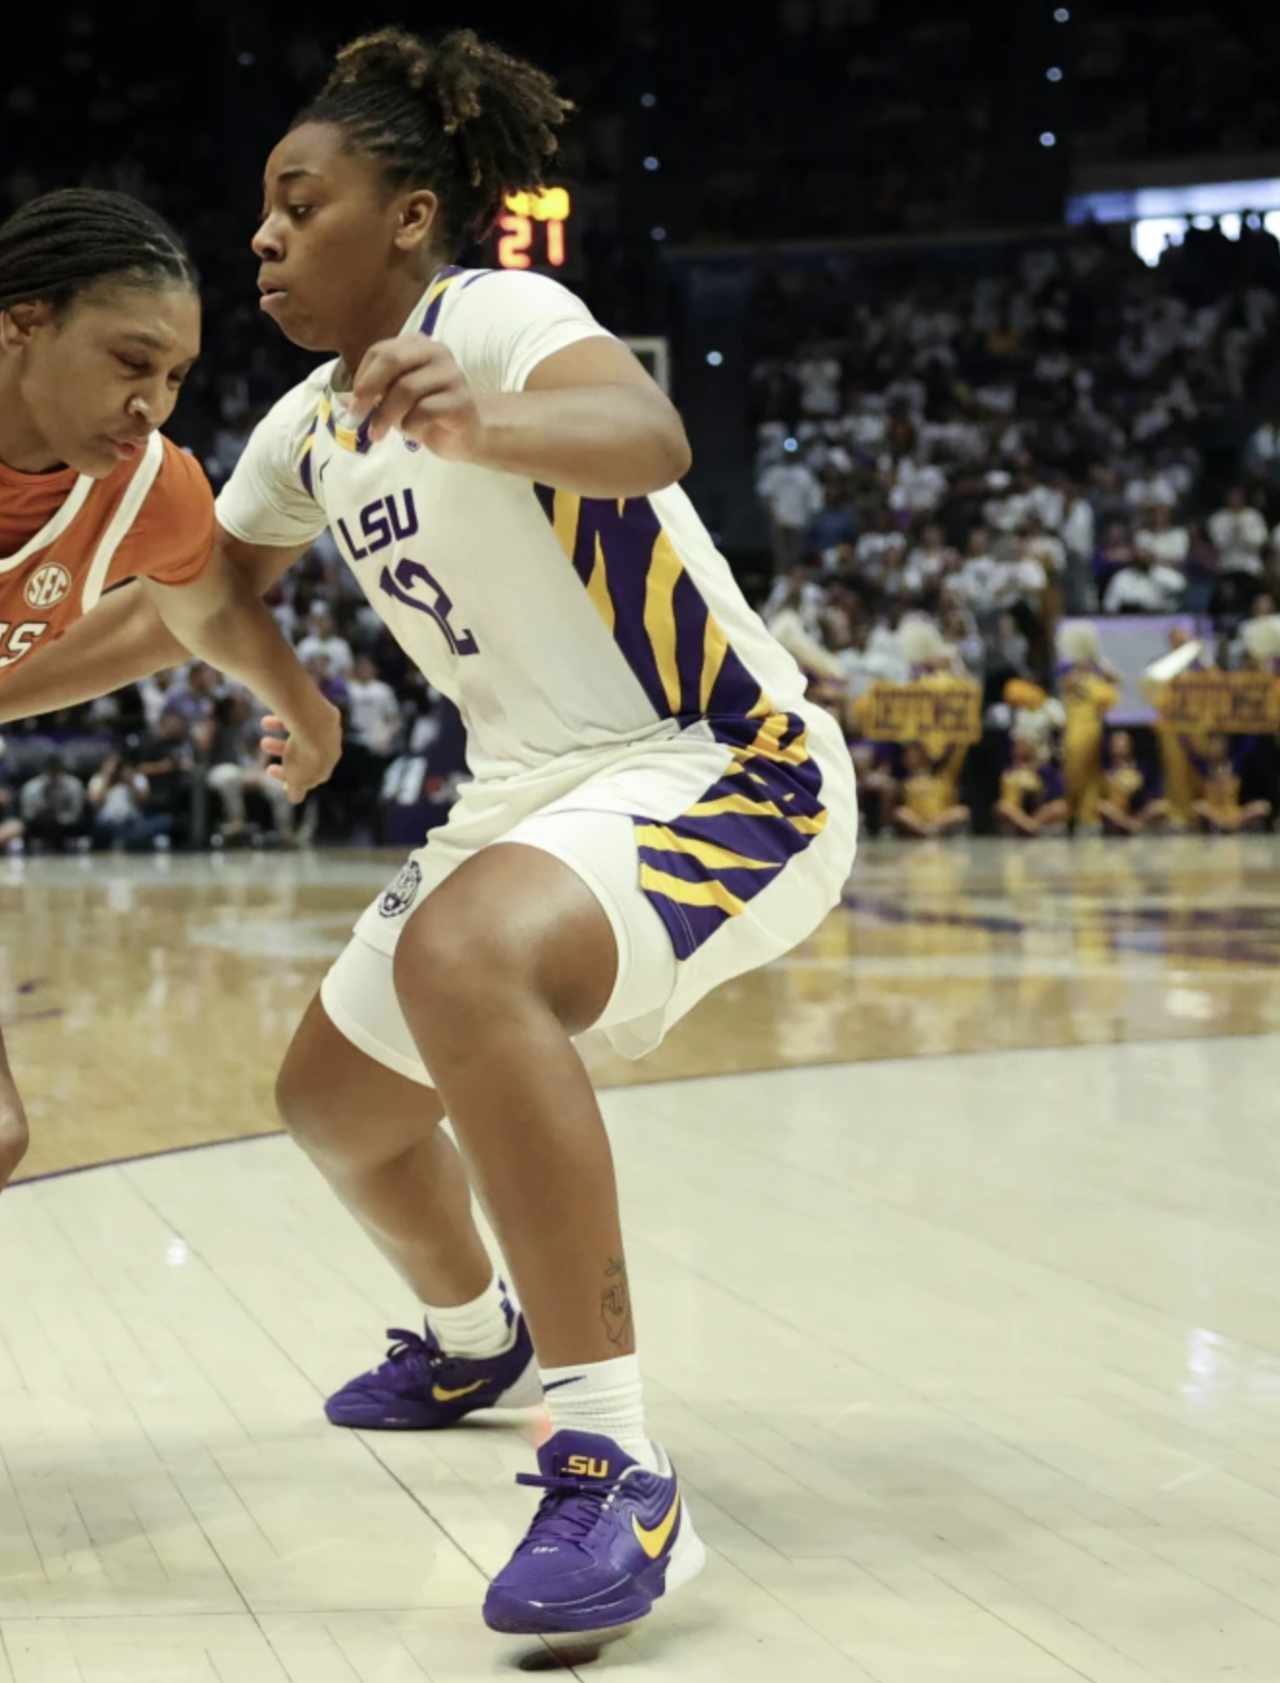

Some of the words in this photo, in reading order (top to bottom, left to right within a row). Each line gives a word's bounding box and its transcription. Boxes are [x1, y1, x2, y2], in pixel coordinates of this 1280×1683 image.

[499, 216, 565, 270] 21
[336, 487, 419, 561] LSU
[26, 564, 70, 607] SEC
[379, 557, 480, 656] 12
[561, 1455, 608, 1478] SU
